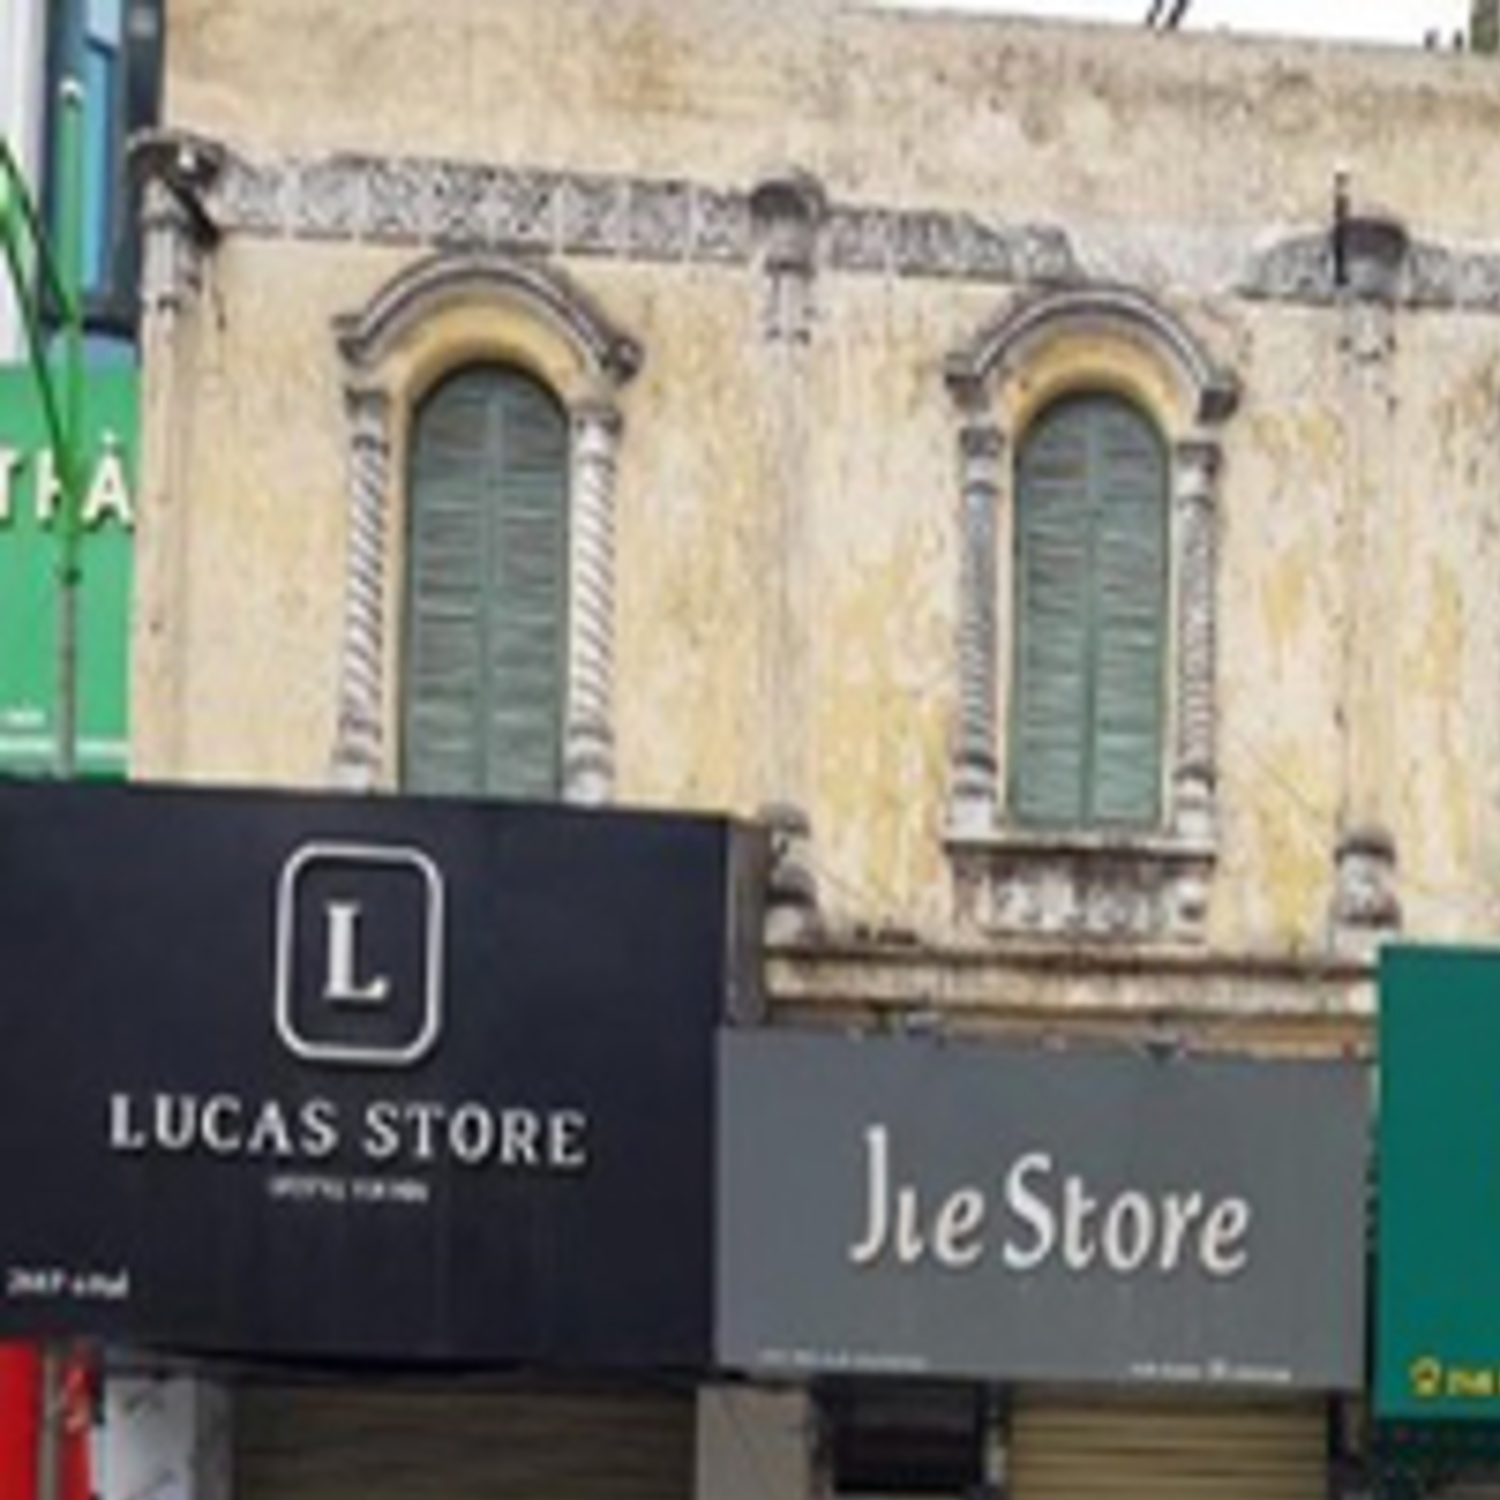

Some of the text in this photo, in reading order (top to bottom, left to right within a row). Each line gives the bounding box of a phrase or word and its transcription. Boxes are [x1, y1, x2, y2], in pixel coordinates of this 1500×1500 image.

[322, 899, 391, 1002] L
[109, 1091, 588, 1168] LUCAS STORE
[1001, 1150, 1251, 1274] Store
